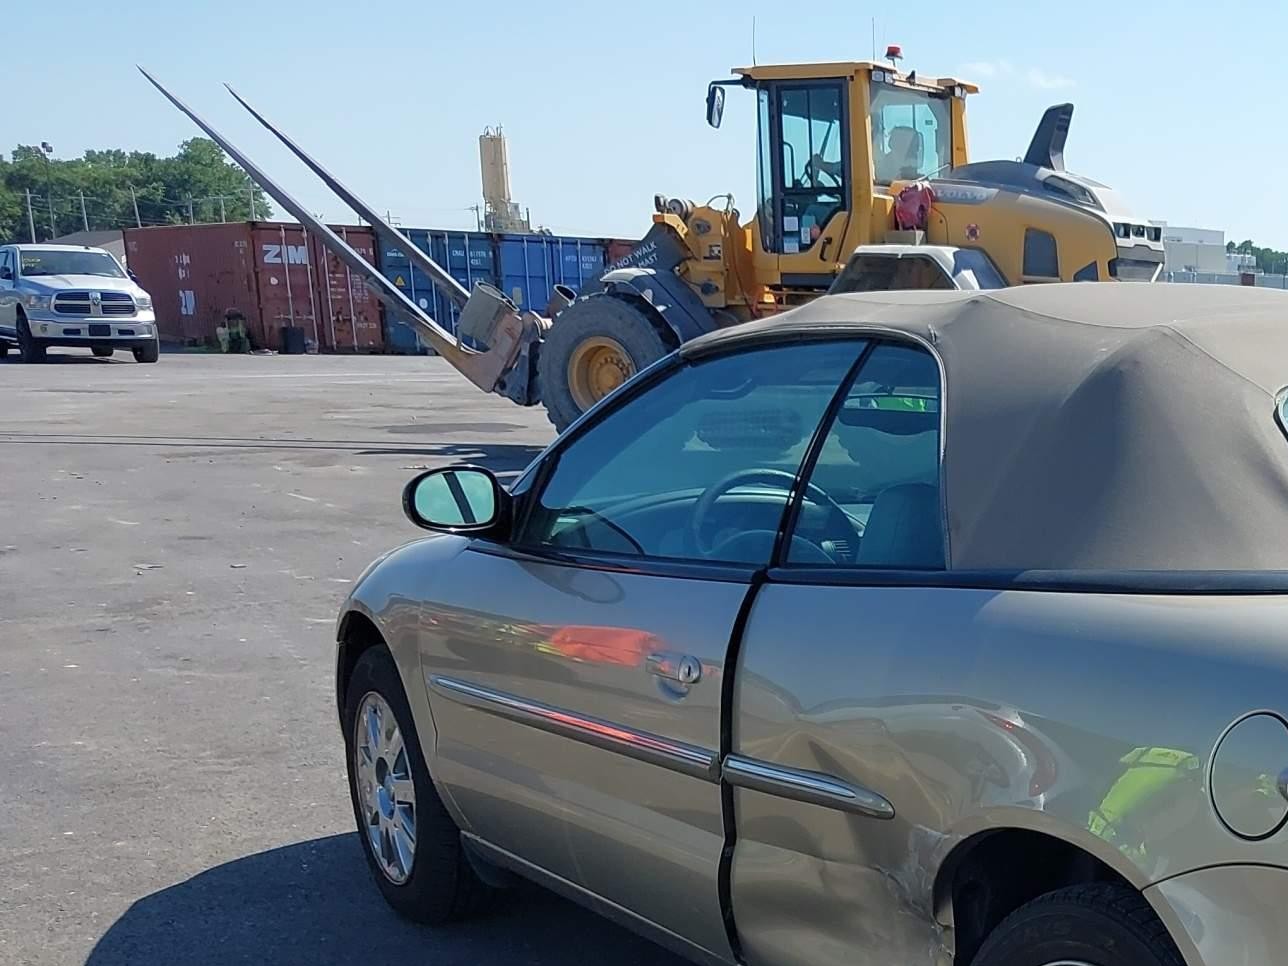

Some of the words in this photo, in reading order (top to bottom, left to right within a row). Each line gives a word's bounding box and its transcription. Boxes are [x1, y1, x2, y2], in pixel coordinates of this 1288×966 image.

[262, 244, 308, 265] ZIM
[617, 255, 634, 268] NOT
[634, 241, 657, 259] WALK
[638, 253, 658, 269] MAST
